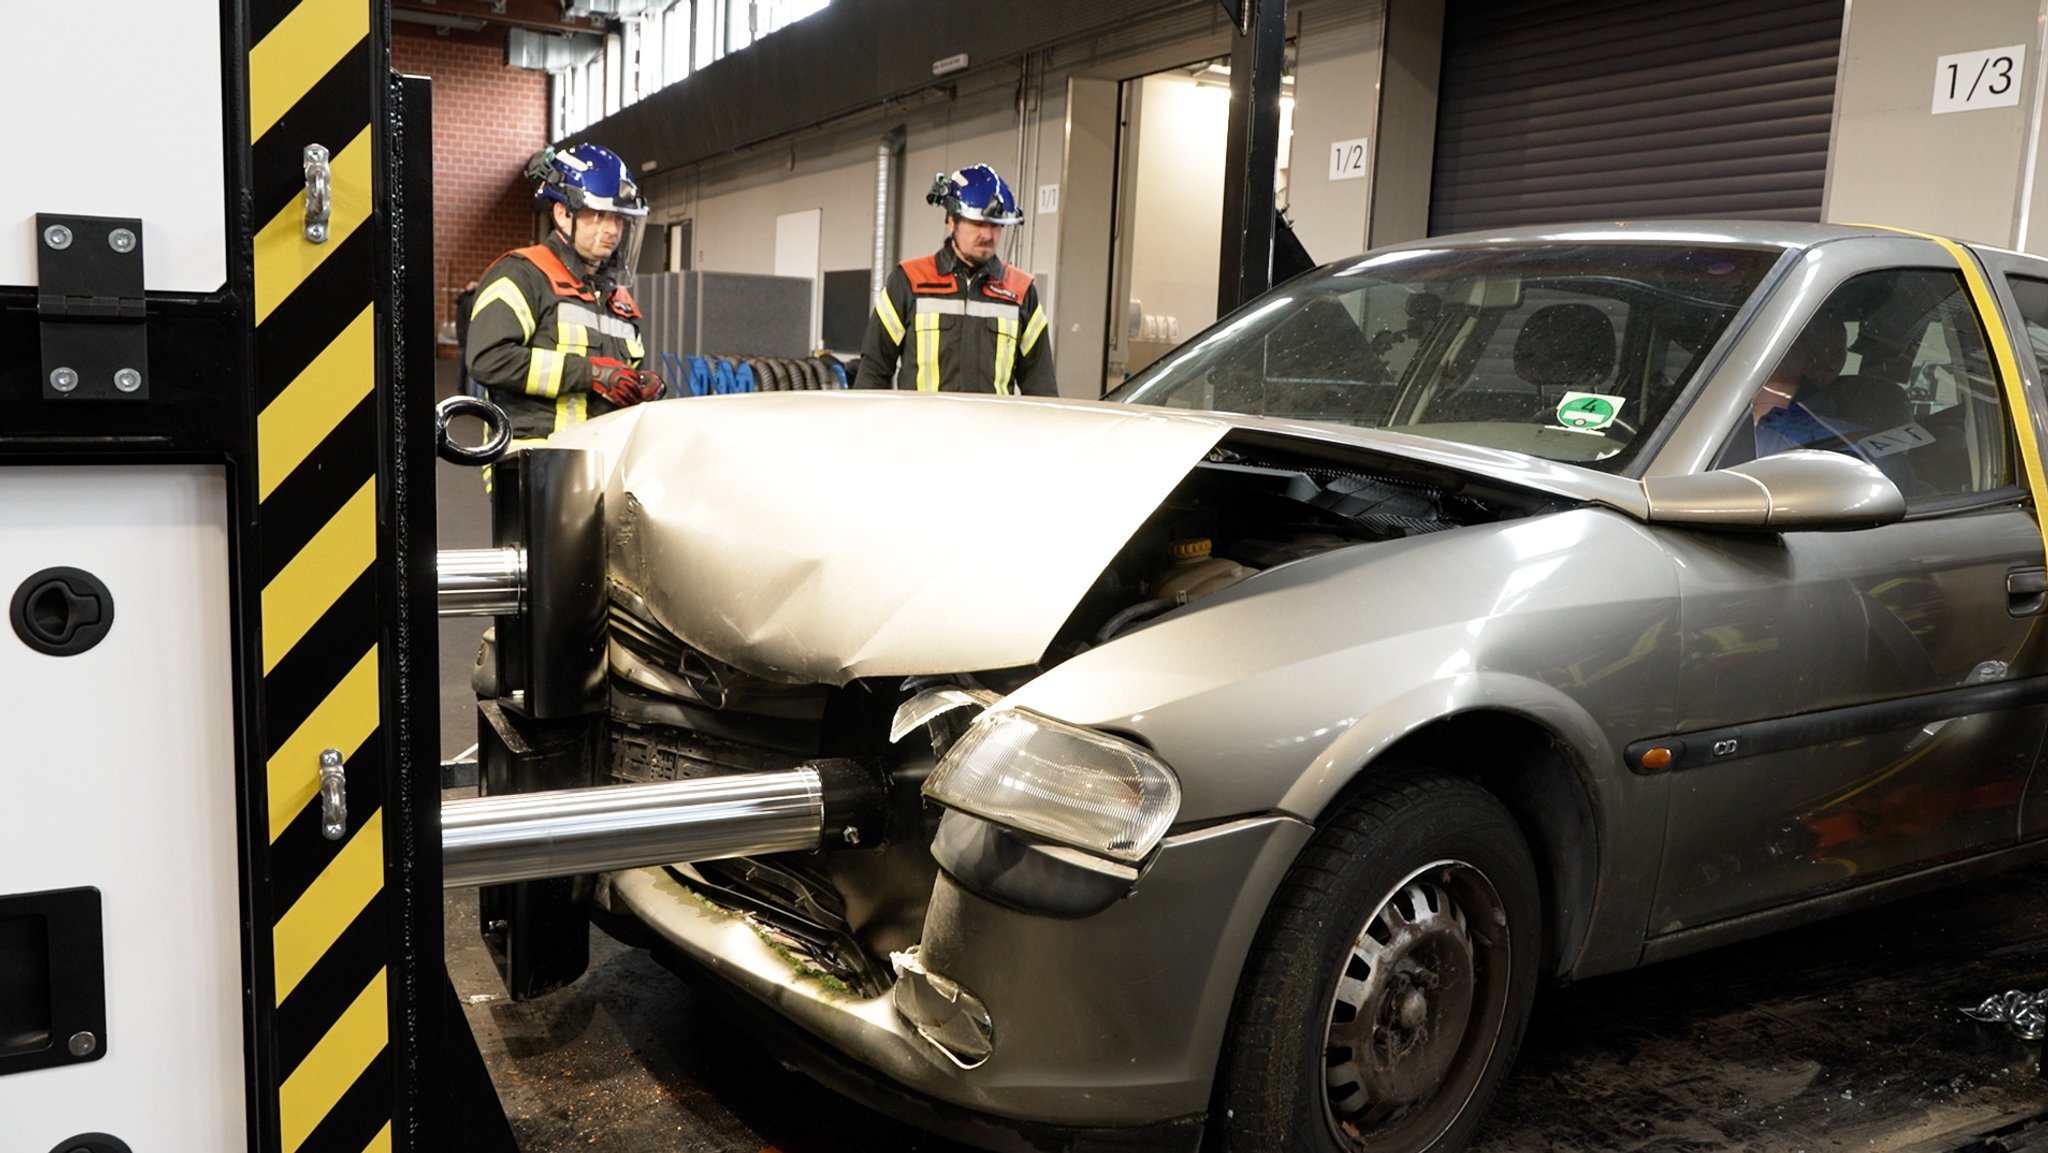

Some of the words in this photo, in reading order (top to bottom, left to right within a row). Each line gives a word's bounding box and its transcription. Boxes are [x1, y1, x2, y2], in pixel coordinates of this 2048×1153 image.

[1947, 56, 2013, 102] 1/3
[1336, 144, 1363, 173] 1/2
[1041, 188, 1056, 209] 1/1
[1581, 399, 1598, 413] 4
[1713, 740, 1737, 756] CD
